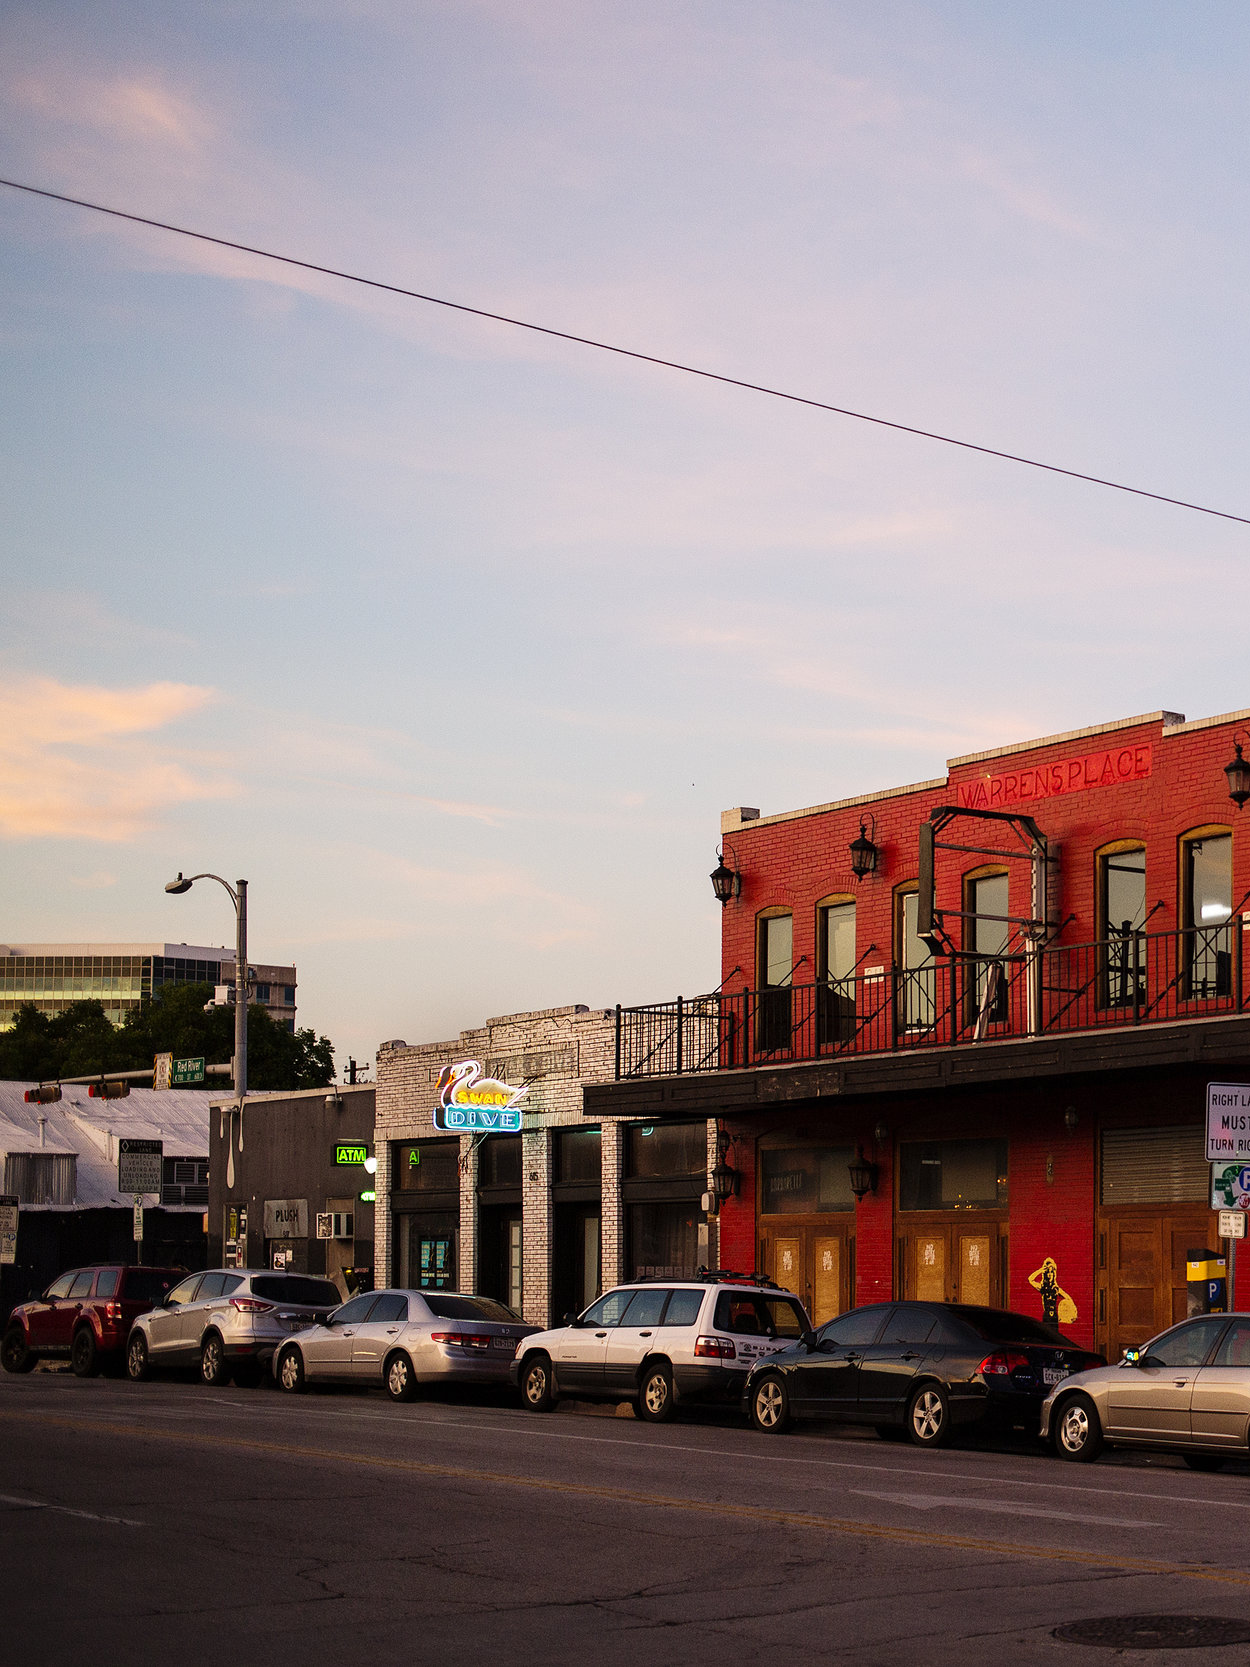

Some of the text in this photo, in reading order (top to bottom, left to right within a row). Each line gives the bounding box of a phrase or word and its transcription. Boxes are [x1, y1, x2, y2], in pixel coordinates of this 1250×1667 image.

[1067, 746, 1150, 789] PLACE
[177, 1061, 187, 1072] Red
[456, 1091, 507, 1106] SWAN
[1211, 1094, 1238, 1106] RIGHT
[449, 1110, 517, 1128] DIVE
[1210, 1138, 1233, 1151] TURN
[338, 1149, 365, 1162] ATM
[275, 1209, 298, 1223] PLUSH
[1209, 1282, 1217, 1298] P
